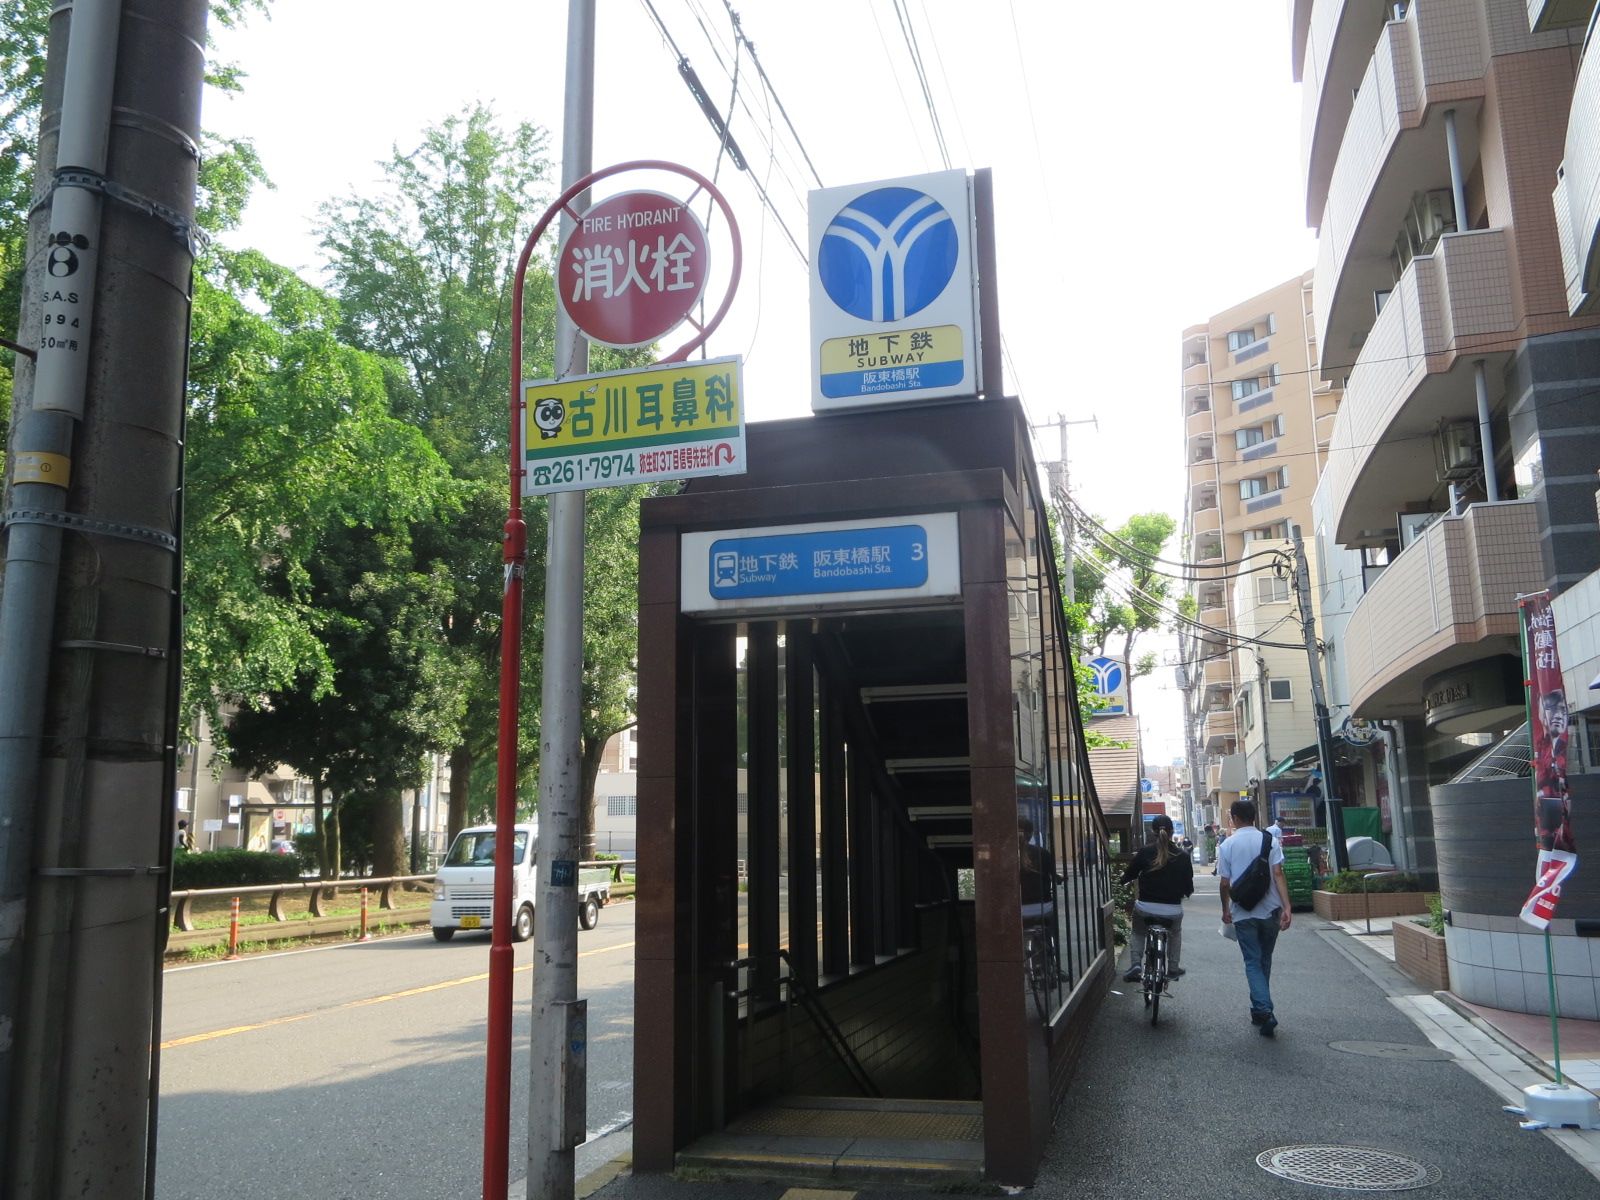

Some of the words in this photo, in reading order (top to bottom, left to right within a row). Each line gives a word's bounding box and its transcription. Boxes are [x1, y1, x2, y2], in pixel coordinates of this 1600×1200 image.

[583, 216, 612, 234] FIRE
[617, 207, 681, 230] HYDRANT
[571, 232, 695, 302] 消火栓
[848, 330, 933, 358] 地下鉄
[857, 351, 925, 368] SUBWAY
[863, 367, 920, 384] 阪東橋駅
[861, 381, 906, 393] Bandobashi
[568, 372, 734, 438] 古川耳鼻科
[552, 453, 635, 484] 261-7974
[639, 443, 714, 474] 弥生町3丁目信号先左折
[739, 551, 798, 572] 地下鉄
[813, 545, 891, 567] 阪東橋駅
[911, 543, 924, 561] 3
[739, 573, 777, 584] Subway
[813, 565, 873, 578] Bandobashi
